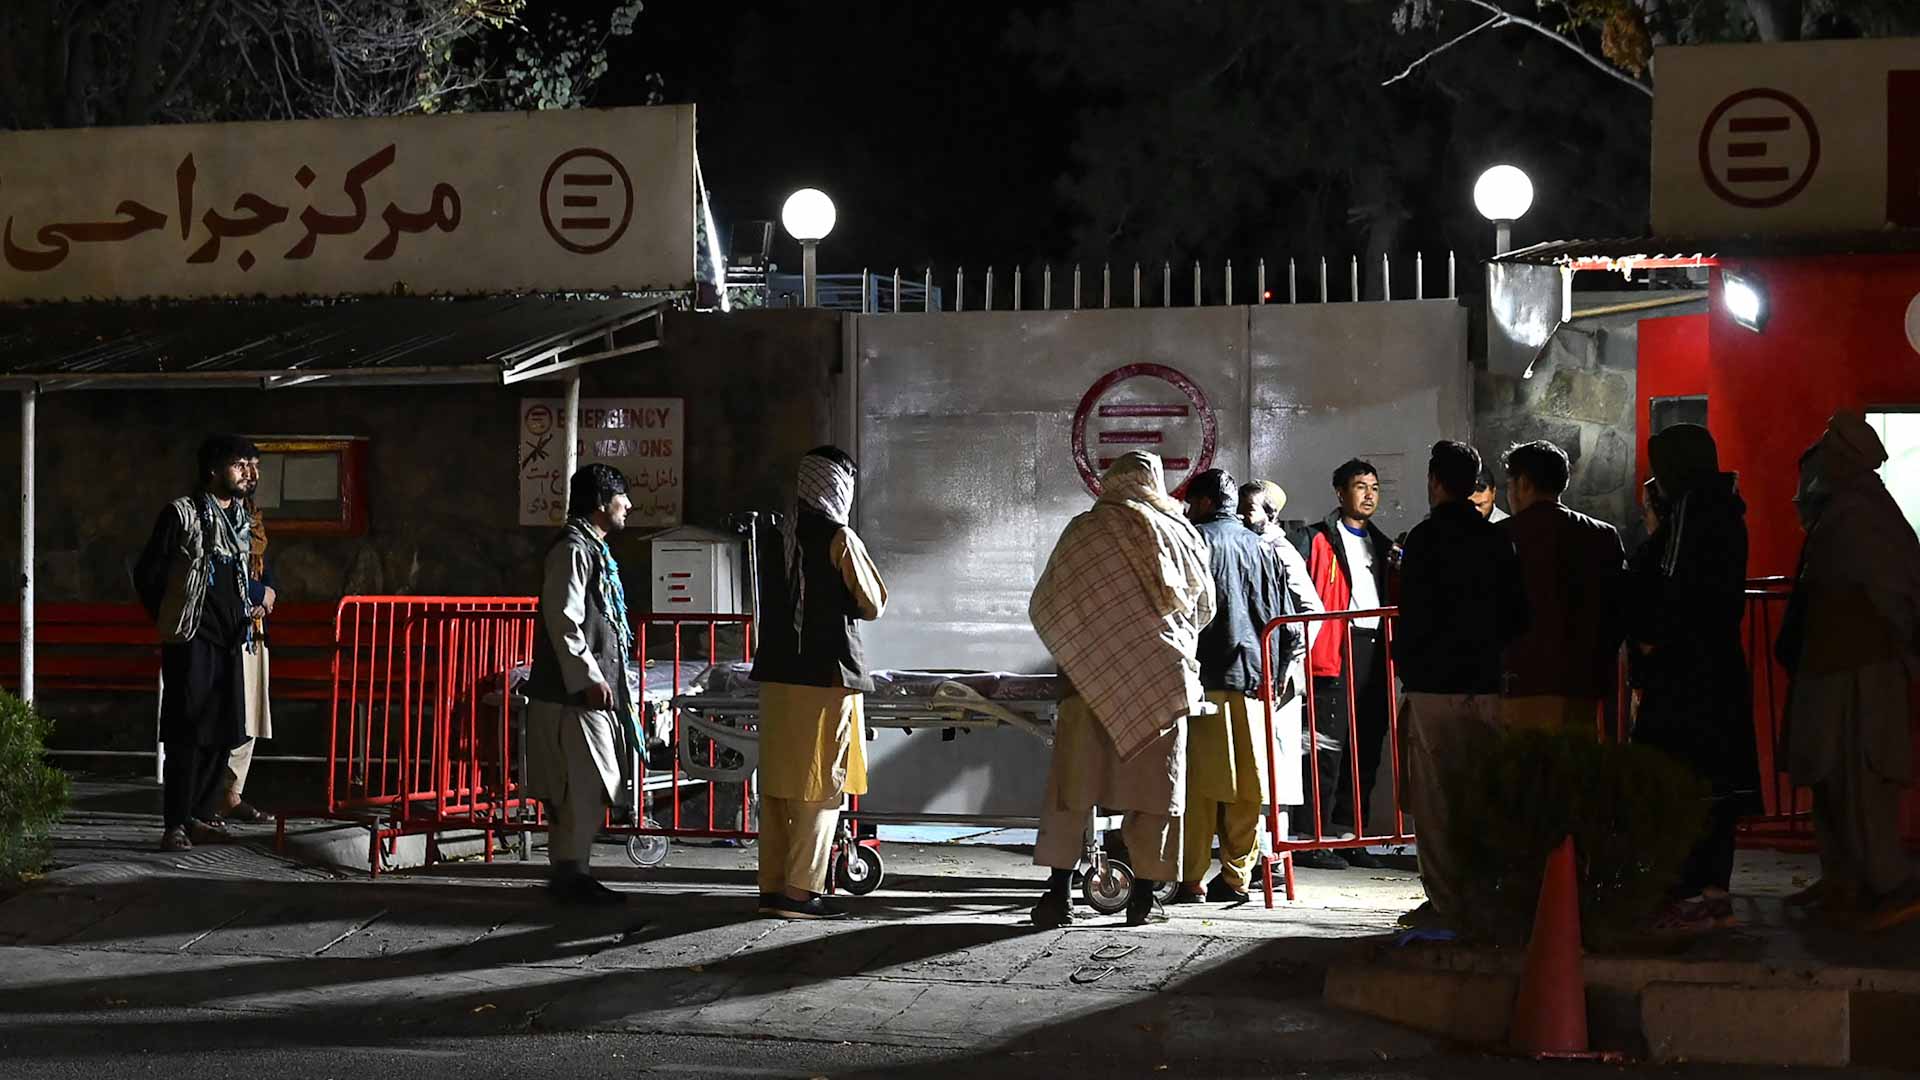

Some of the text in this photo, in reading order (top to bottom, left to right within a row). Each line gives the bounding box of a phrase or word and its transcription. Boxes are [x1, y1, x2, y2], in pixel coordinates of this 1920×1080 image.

[3, 143, 462, 272] مرکز جراحی
[557, 407, 671, 429] EERGENCY
